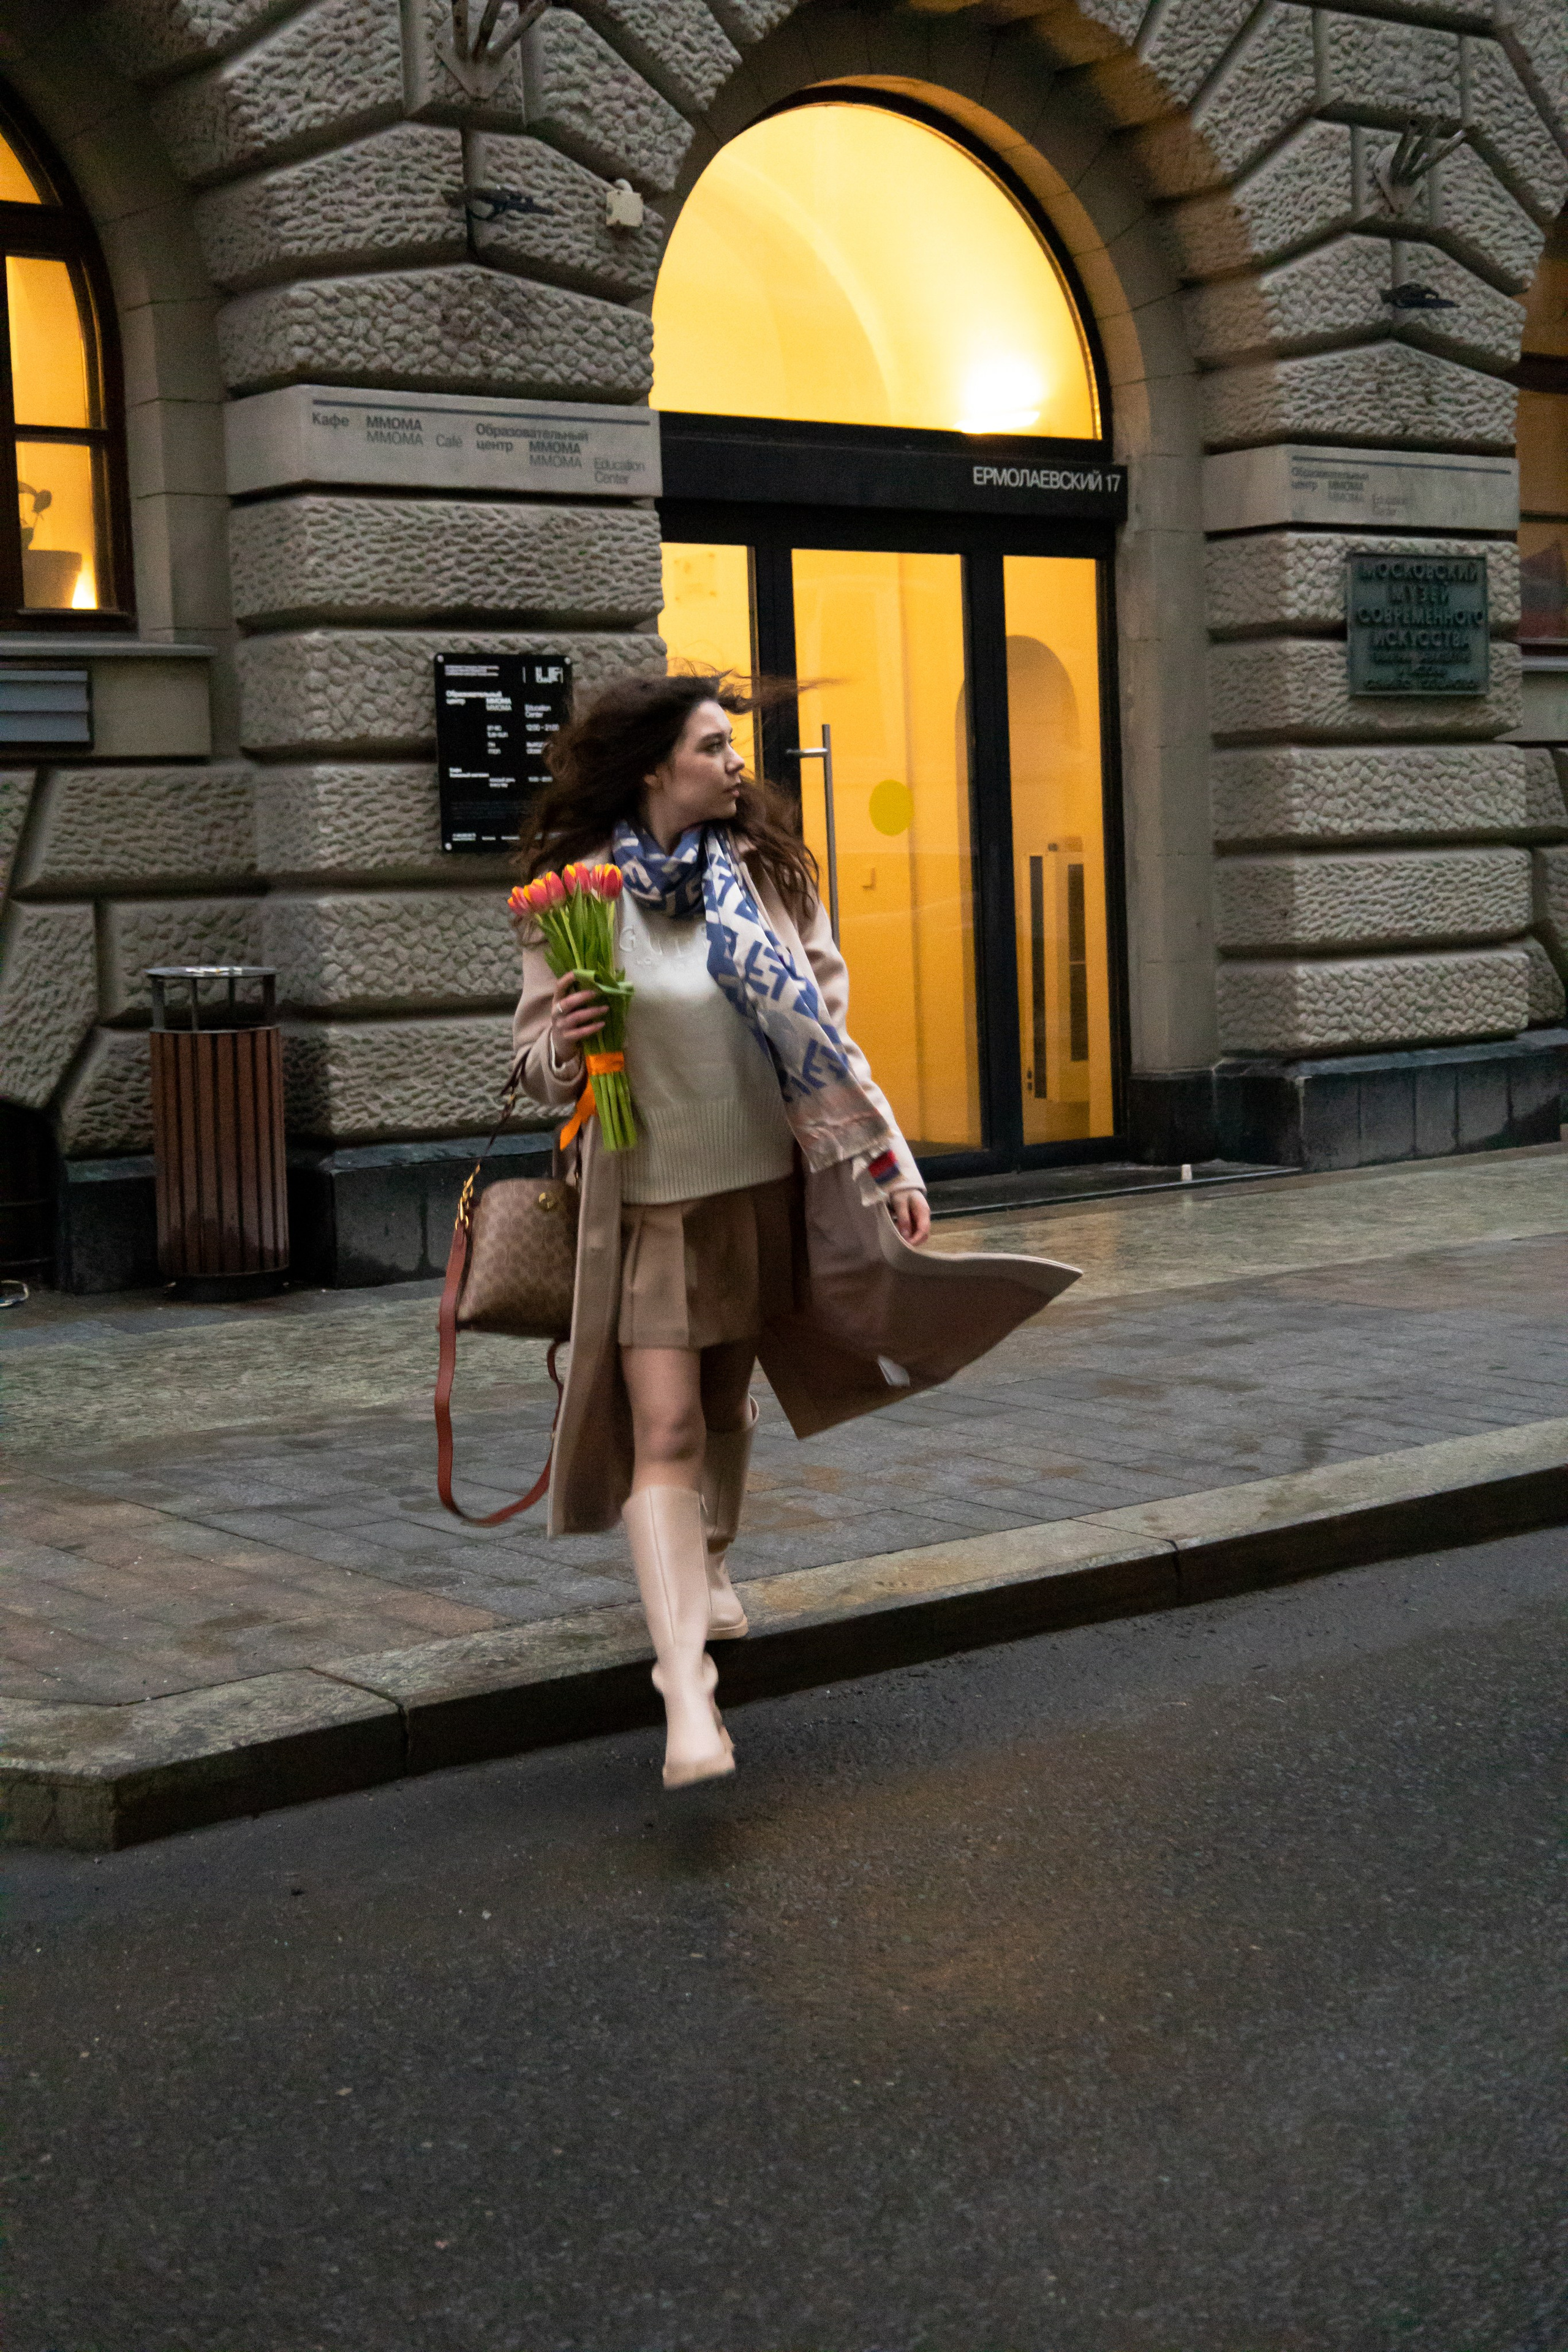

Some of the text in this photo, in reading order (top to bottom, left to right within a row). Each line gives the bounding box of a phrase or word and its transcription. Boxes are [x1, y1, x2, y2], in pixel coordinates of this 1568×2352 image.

[312, 412, 350, 429] Кафе
[366, 431, 424, 445] MMOMA
[476, 423, 589, 442] Образовательный
[477, 440, 514, 453] центр
[529, 455, 646, 472] MMOMA Education
[973, 466, 1121, 492] ЕРМОЛАЕВСКИЙ 17
[1359, 561, 1477, 581] МОСКОВСКИЙ
[1389, 582, 1450, 605] МУЗЕЙ
[1357, 606, 1485, 625] СОВРЕМЕННОГО
[1371, 630, 1470, 648] ИСКУССТВА
